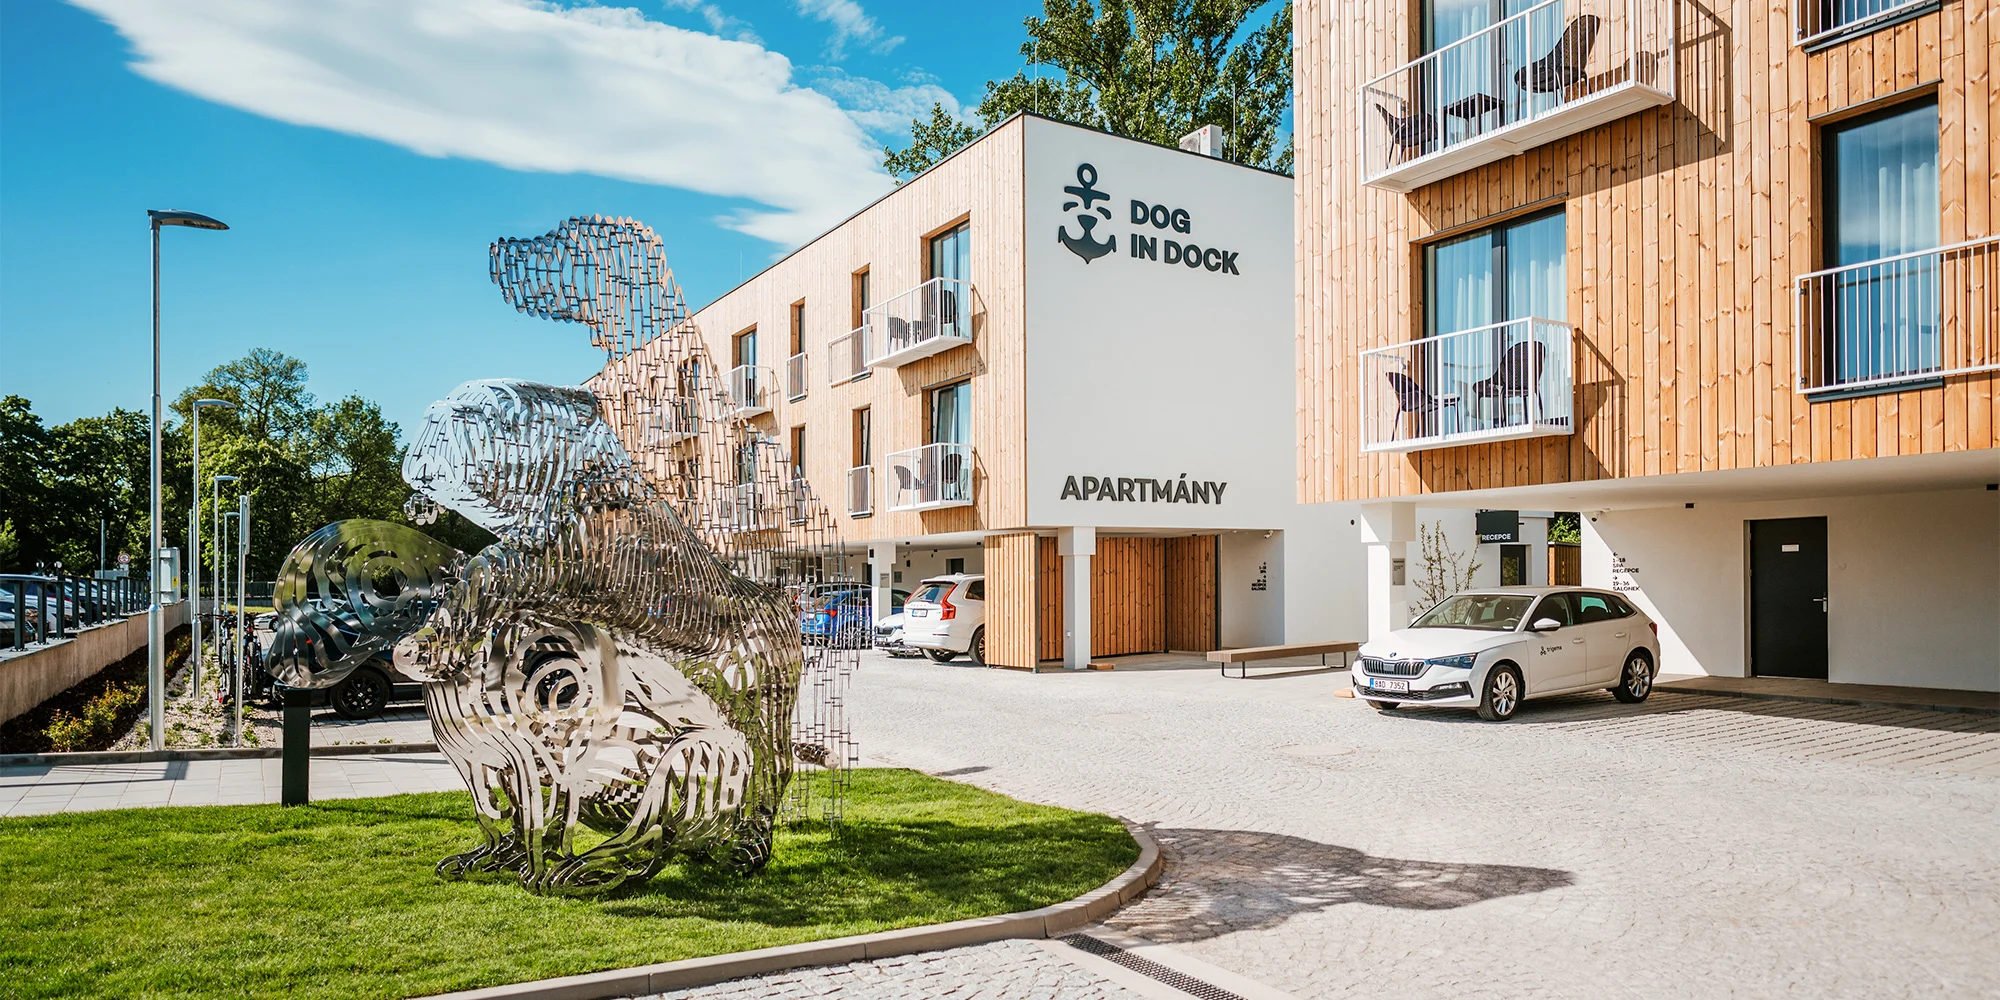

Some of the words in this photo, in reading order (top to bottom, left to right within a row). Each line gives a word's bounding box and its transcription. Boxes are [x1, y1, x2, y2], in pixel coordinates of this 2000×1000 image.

[1130, 199, 1191, 234] DOG
[1130, 233, 1157, 261] IN
[1164, 239, 1240, 276] DOCK
[1060, 472, 1228, 505] APARTMÁNY
[1482, 533, 1512, 541] RECEPCE
